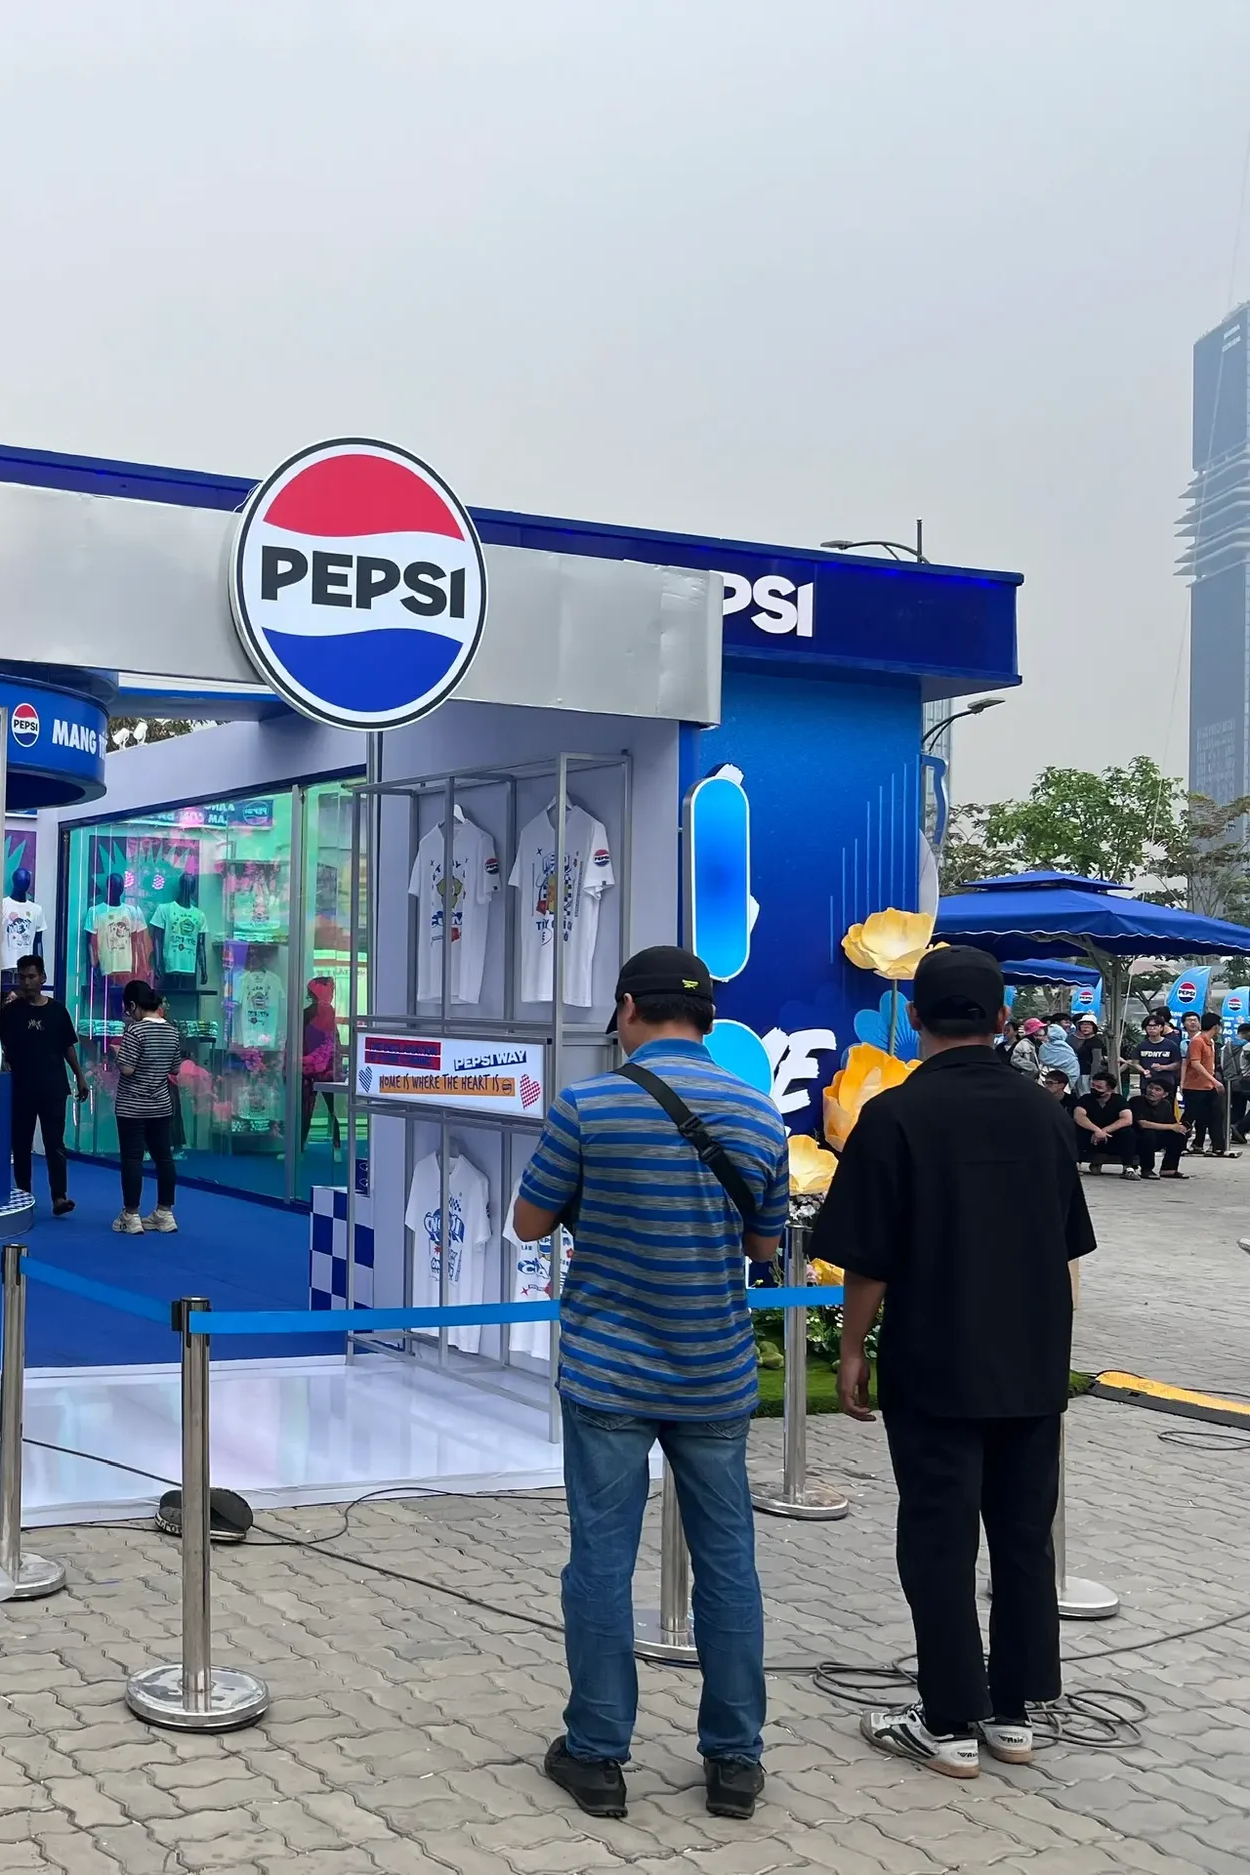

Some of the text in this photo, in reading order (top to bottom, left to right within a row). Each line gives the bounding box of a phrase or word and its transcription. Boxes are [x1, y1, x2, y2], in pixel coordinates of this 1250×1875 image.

[261, 545, 466, 619] PEPSI
[13, 719, 38, 732] PEPSI
[52, 719, 97, 755] MANG
[1178, 989, 1196, 997] PEPSI
[455, 1050, 526, 1070] PEPSI WAY
[380, 1075, 401, 1088] HOME
[403, 1073, 410, 1089] IS
[412, 1075, 440, 1089] WHERE
[442, 1073, 459, 1090] THE
[461, 1074, 491, 1091] HEART
[493, 1074, 500, 1092] IS
